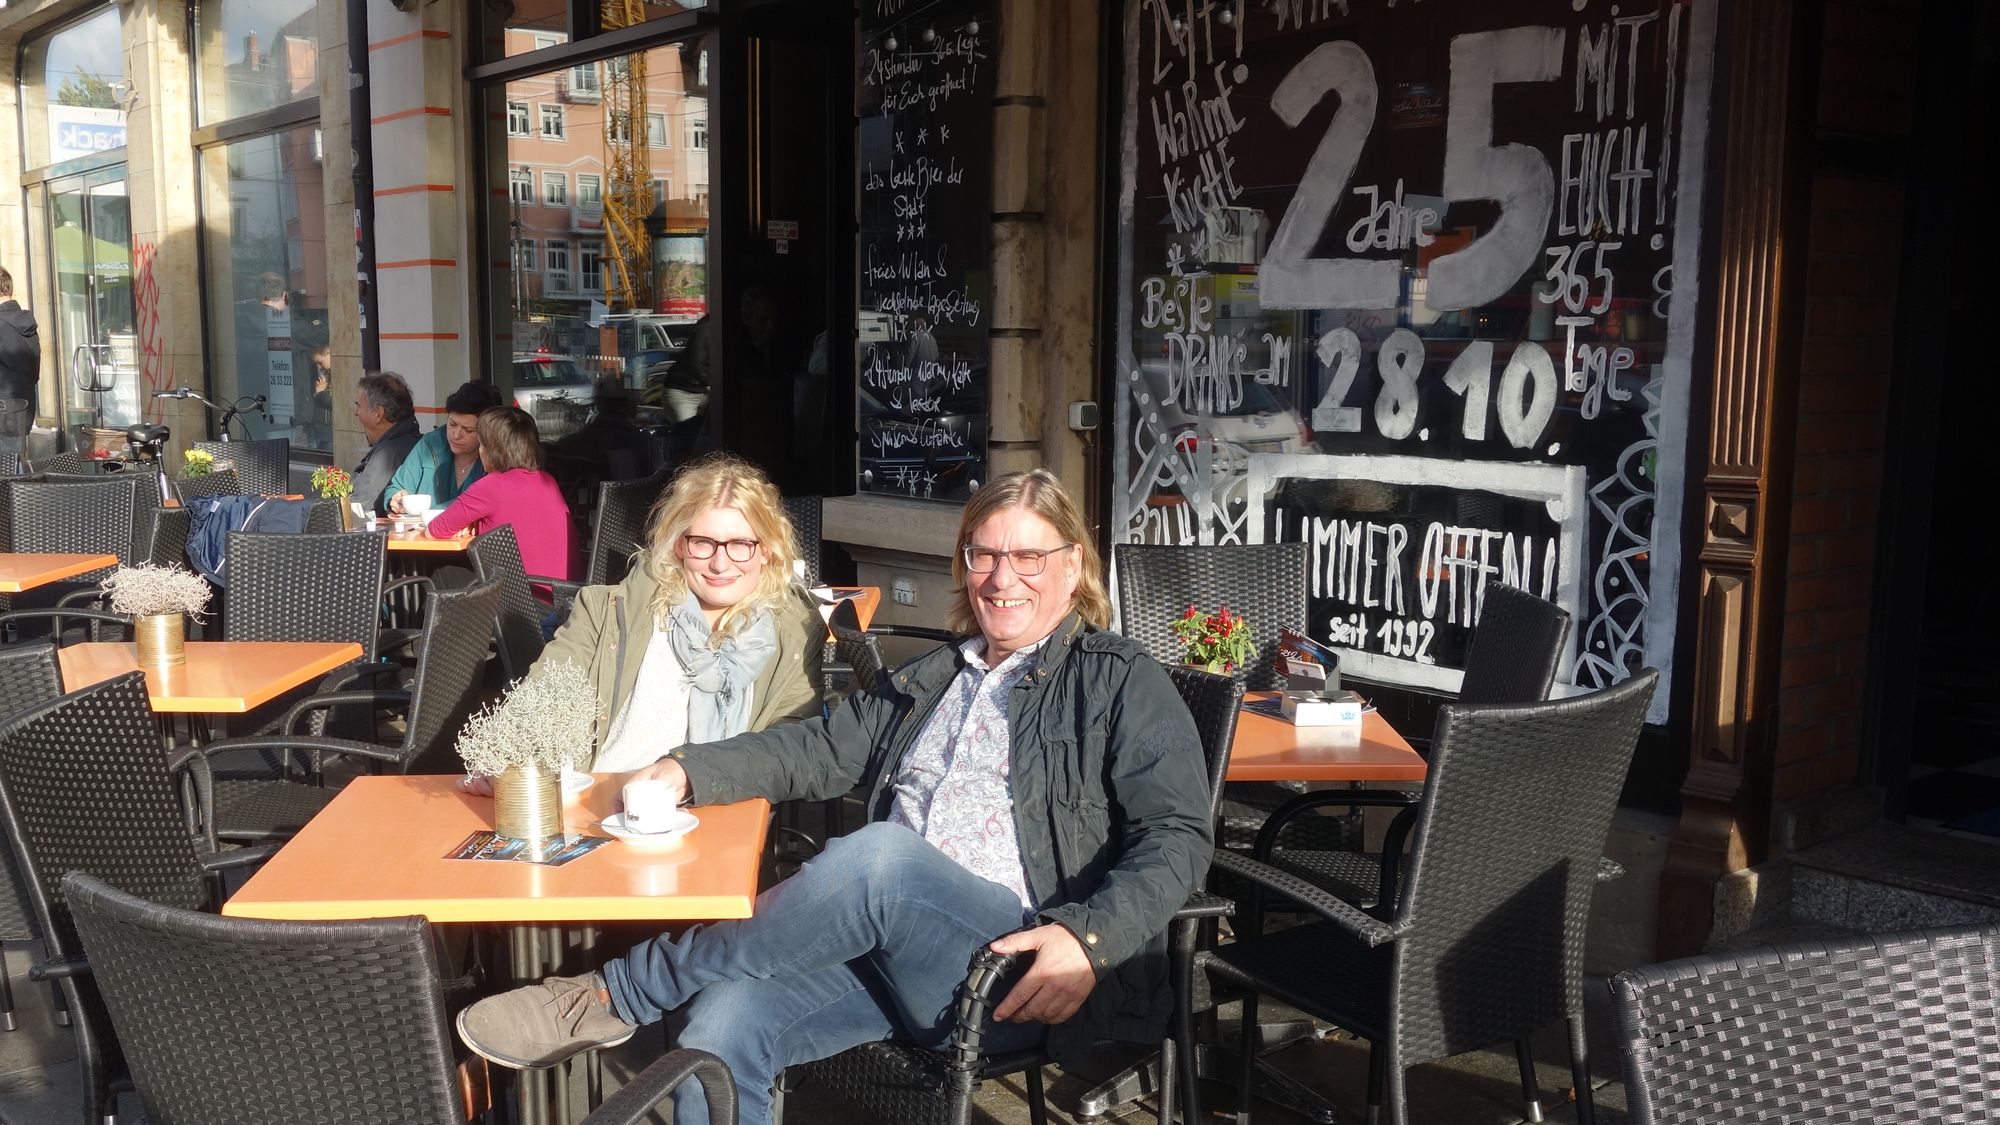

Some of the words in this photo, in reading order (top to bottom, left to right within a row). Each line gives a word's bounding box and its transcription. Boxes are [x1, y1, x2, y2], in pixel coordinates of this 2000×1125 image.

[881, 84, 898, 119] für
[865, 162, 885, 190] das
[916, 156, 942, 199] Bier
[947, 156, 964, 184] der
[893, 195, 925, 220] Stadt
[1346, 178, 1438, 253] Jahre
[1539, 242, 1622, 314] 365
[272, 361, 289, 371] Telefon
[1555, 316, 1635, 420] Tage
[1376, 617, 1436, 665] 1992
